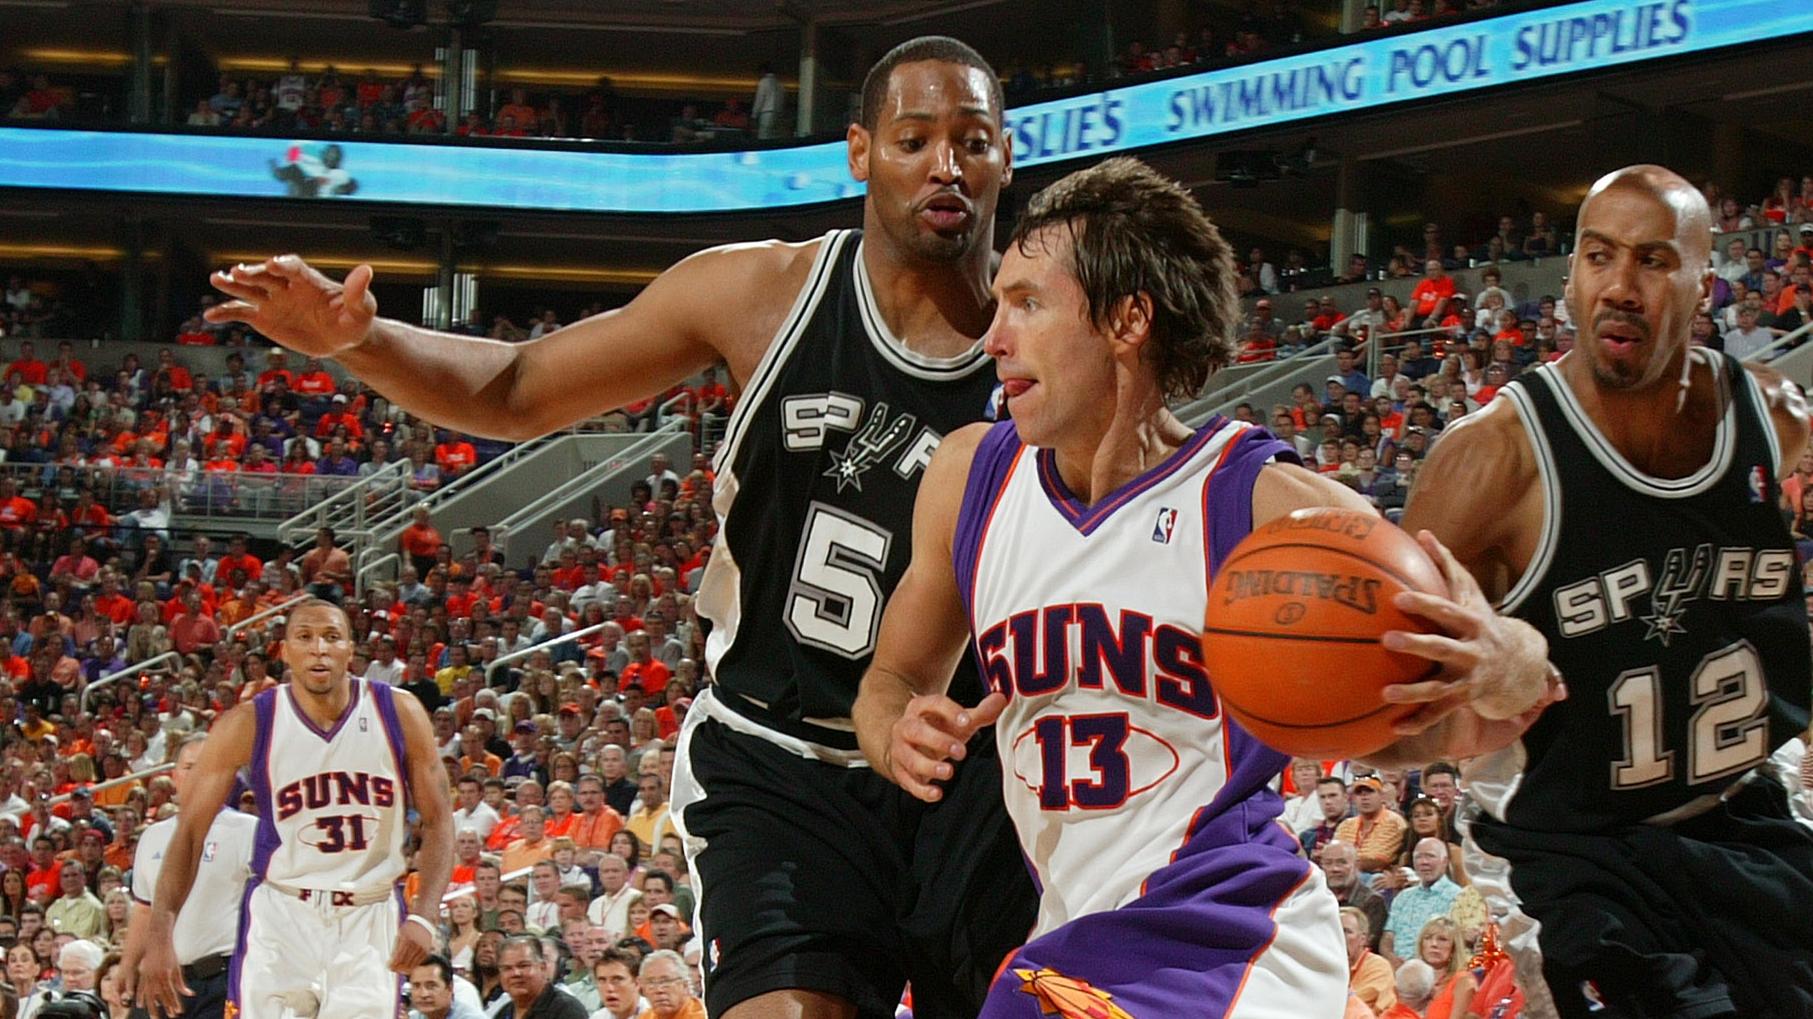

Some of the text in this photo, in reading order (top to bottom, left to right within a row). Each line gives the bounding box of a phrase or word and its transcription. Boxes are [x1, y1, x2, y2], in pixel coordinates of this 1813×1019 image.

[1004, 0, 1689, 162] SLIE'S SWIMMING POOL SUPPLIES
[782, 500, 894, 661] 5
[1224, 570, 1382, 615] SPALDING
[1553, 543, 1794, 647] SPURS
[978, 602, 1220, 720] SUNS
[1034, 711, 1131, 811] 13
[1607, 638, 1770, 791] 12
[276, 770, 395, 823] SUNS
[316, 814, 368, 854] 31
